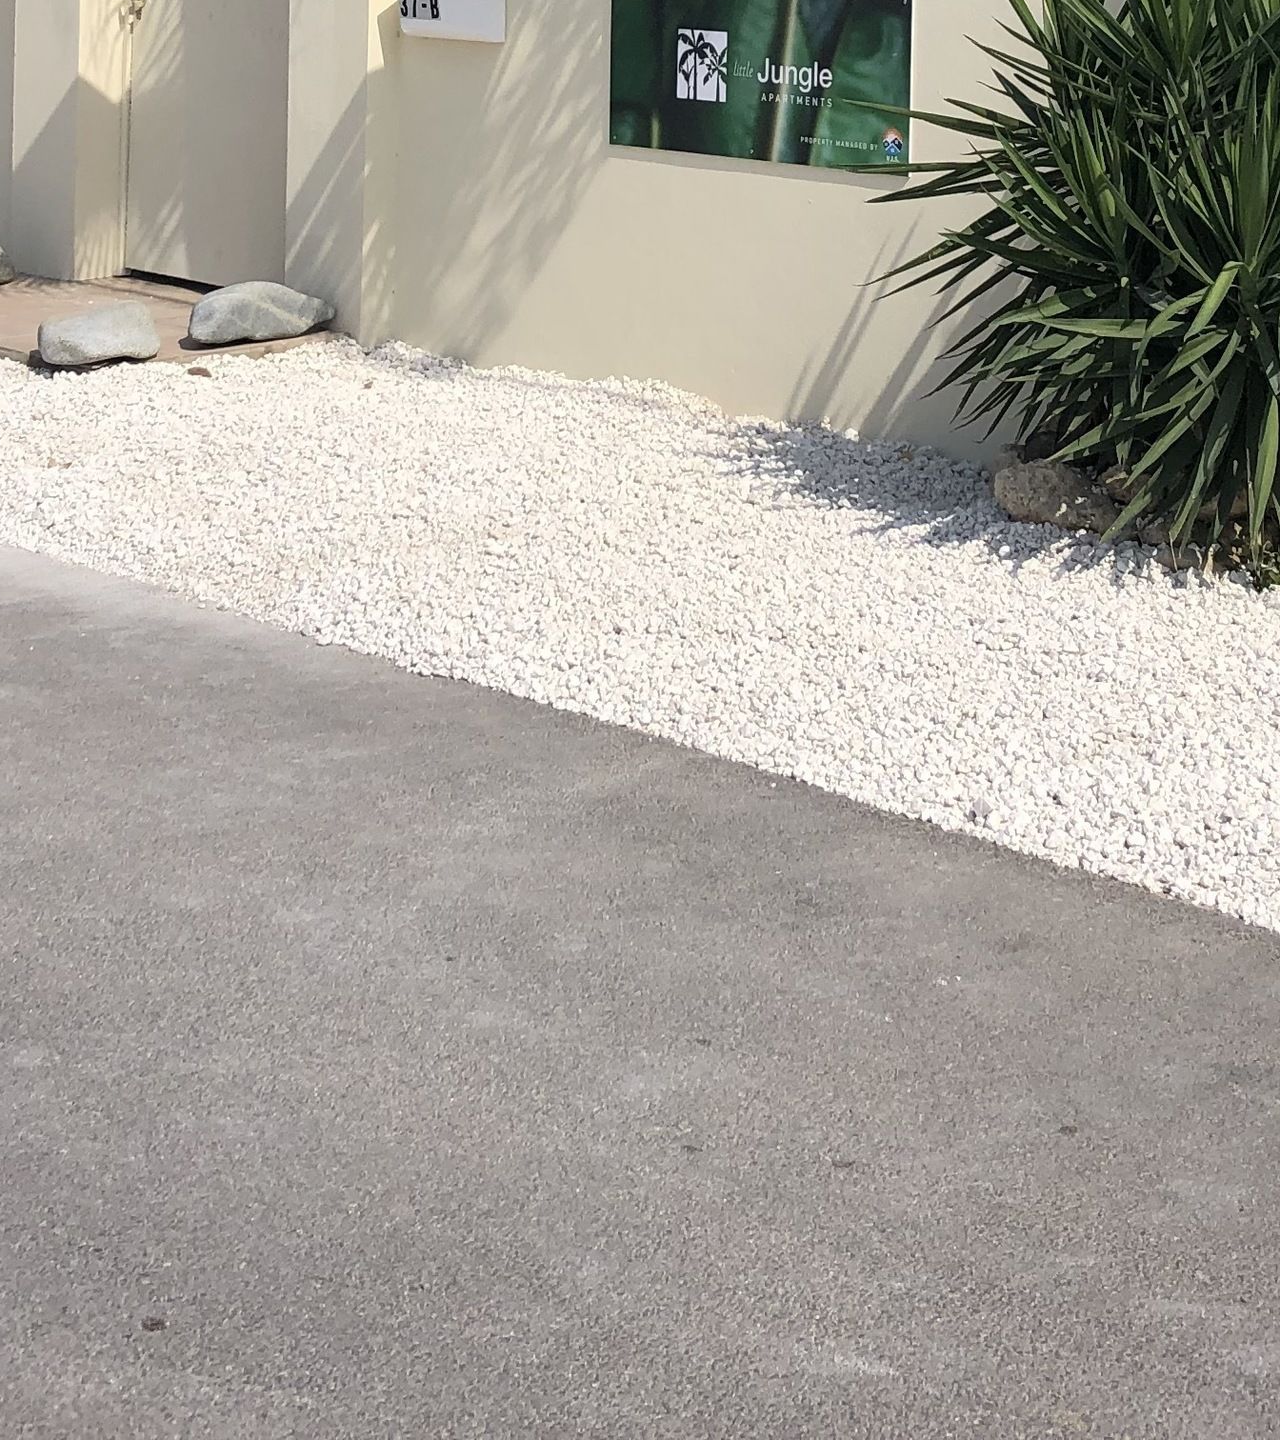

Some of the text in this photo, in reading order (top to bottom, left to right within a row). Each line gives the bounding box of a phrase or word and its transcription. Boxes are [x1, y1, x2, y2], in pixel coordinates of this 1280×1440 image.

[757, 57, 833, 93] Jungle
[761, 93, 833, 108] APARTMENTS
[800, 136, 833, 146] PROPERTY
[835, 140, 867, 150] MANAGED
